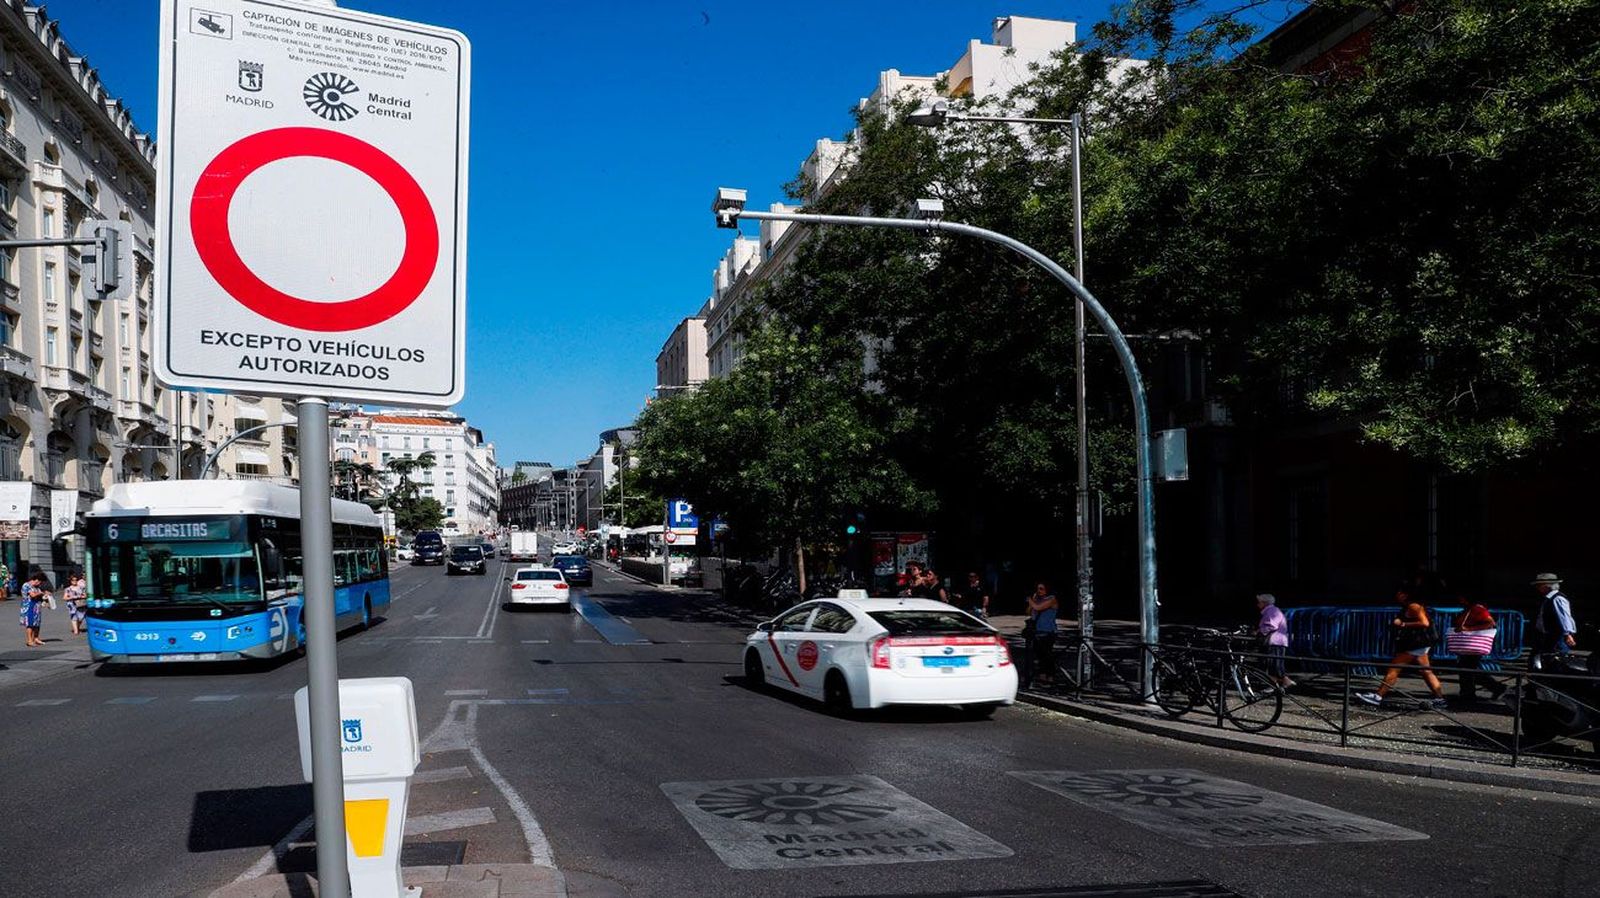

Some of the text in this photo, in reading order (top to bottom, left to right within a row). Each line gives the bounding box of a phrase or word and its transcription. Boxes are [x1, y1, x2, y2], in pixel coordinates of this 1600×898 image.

[242, 30, 279, 42] DIRECCIÓN
[243, 10, 300, 28] CAPTACIÓN
[304, 21, 318, 31] DE
[377, 35, 390, 44] DE
[394, 38, 448, 55] VEHÍCULOS
[249, 22, 294, 35] Tratamiento
[296, 31, 332, 42] conforme
[346, 39, 388, 52] Reglamento
[384, 63, 407, 72] Madrid
[225, 94, 274, 109] MADRID
[368, 92, 411, 108] Madrid
[366, 105, 412, 120] Central
[200, 330, 424, 363] EXCEPTO VEHÍCULOS
[238, 355, 390, 380] AUTORIZADOS
[676, 500, 693, 522] P
[108, 523, 208, 539] 6 ORCASITAS
[762, 827, 931, 846] Madrid
[775, 840, 956, 861] Central
